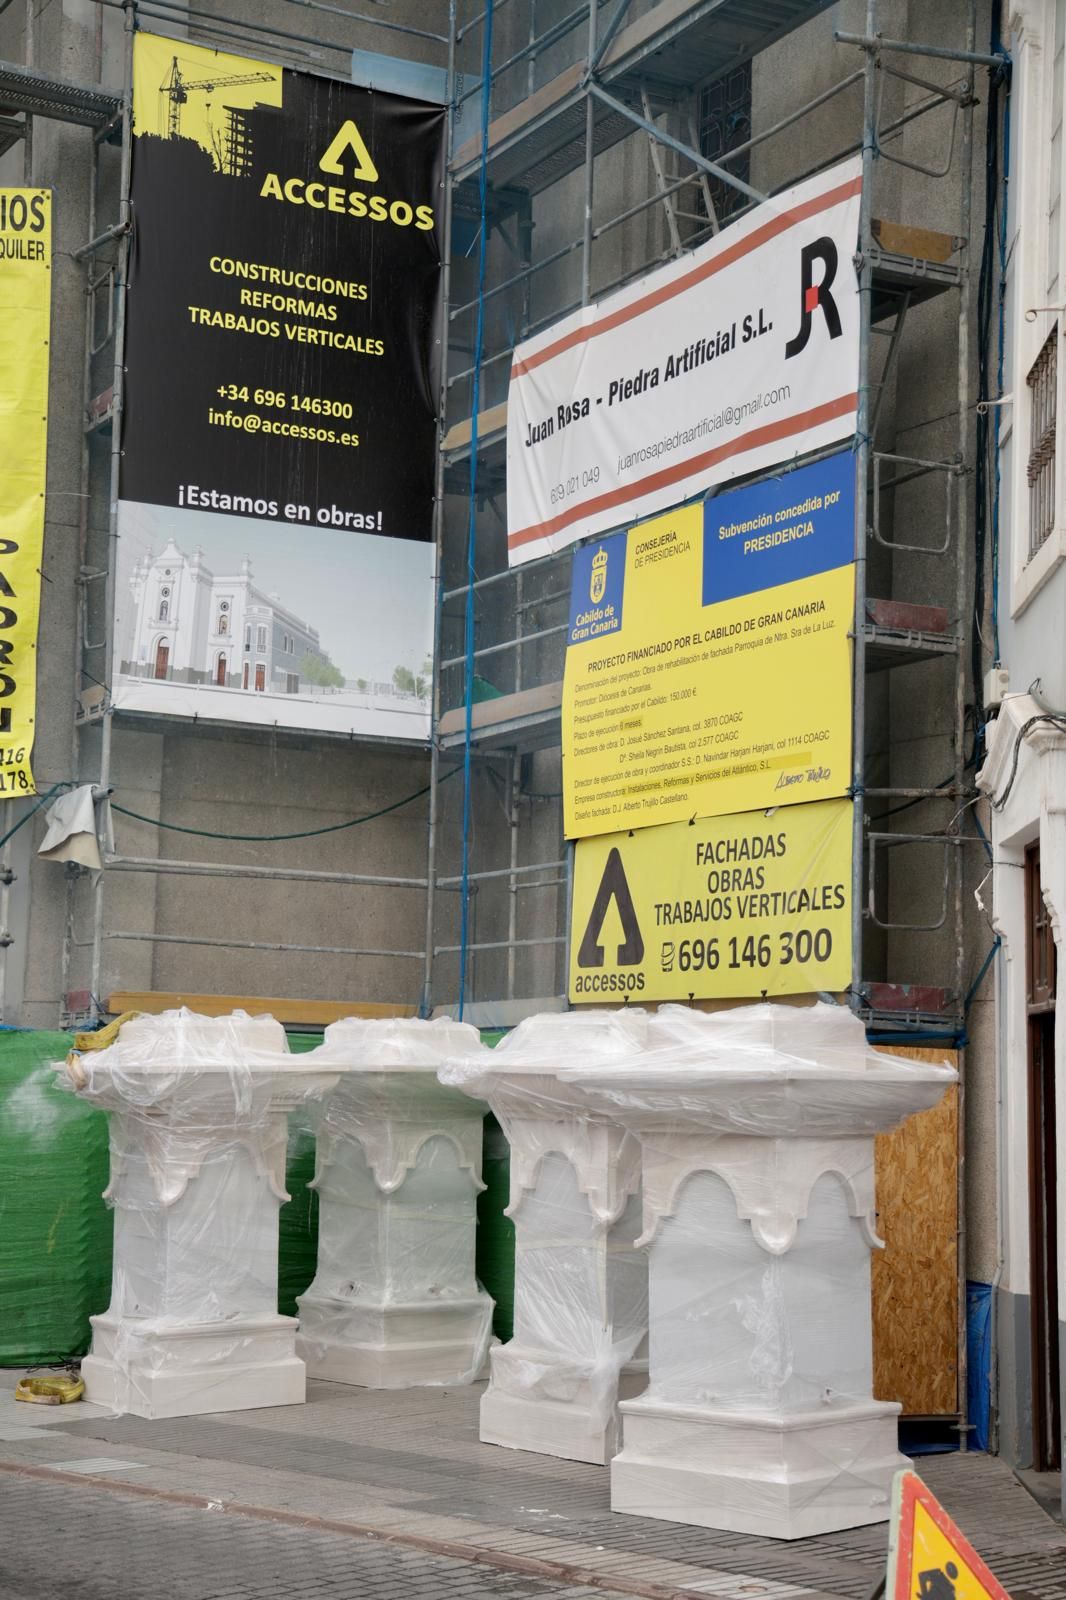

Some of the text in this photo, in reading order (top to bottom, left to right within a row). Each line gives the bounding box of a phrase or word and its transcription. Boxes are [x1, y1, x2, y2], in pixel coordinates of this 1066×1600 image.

[260, 172, 434, 231] ACCESSOS
[209, 256, 368, 301] CONSTRUCCIONES
[240, 289, 338, 321] REFORMAS
[188, 306, 385, 357] TRABAJOS VERTICALES
[525, 414, 554, 448] Juan
[557, 396, 590, 431] Rosa
[608, 366, 659, 406] Piedra
[664, 322, 736, 382] Artificial
[742, 307, 773, 344] S.L.
[216, 383, 353, 420] +34 696 146300
[208, 407, 359, 447] info@accessos.es
[582, 465, 600, 488] 049
[617, 384, 790, 476] juanrosapiedraartificial@gmail.com
[178, 484, 383, 532] ¡Estamos en obras!
[719, 490, 841, 541] Subvención concedida por
[634, 540, 690, 569] DE PRESIDENCIA
[635, 530, 677, 555] CONSEJERÍA
[743, 520, 814, 555] PRESIDENCIA
[571, 616, 618, 641] Gran Canaria
[575, 604, 614, 627] Cabildo de
[588, 600, 826, 672] PROYECTO FINANCIADO POR EL CABILDO DE GRAN CANARIA
[656, 663, 664, 671] de
[701, 651, 710, 660] de
[710, 645, 733, 658] fachada
[734, 638, 763, 653] Parroquia
[764, 635, 773, 644] de
[803, 625, 812, 634] de
[812, 623, 821, 633] La
[715, 730, 739, 744] COAGC
[719, 711, 743, 726] COAGC
[624, 770, 631, 779] de
[631, 767, 644, 777] obra
[649, 760, 680, 773] coordinador
[787, 736, 802, 747] 1114
[803, 730, 830, 744] COAGC
[663, 775, 690, 787] Reformas
[695, 770, 720, 782] Servicios
[721, 767, 731, 777] del
[696, 832, 786, 866] FACHADAS
[707, 866, 765, 894] OBRAS
[654, 883, 845, 926] TRABAJOS VERTICALES
[678, 928, 833, 972] 696 146 300
[575, 971, 645, 993] accessos
